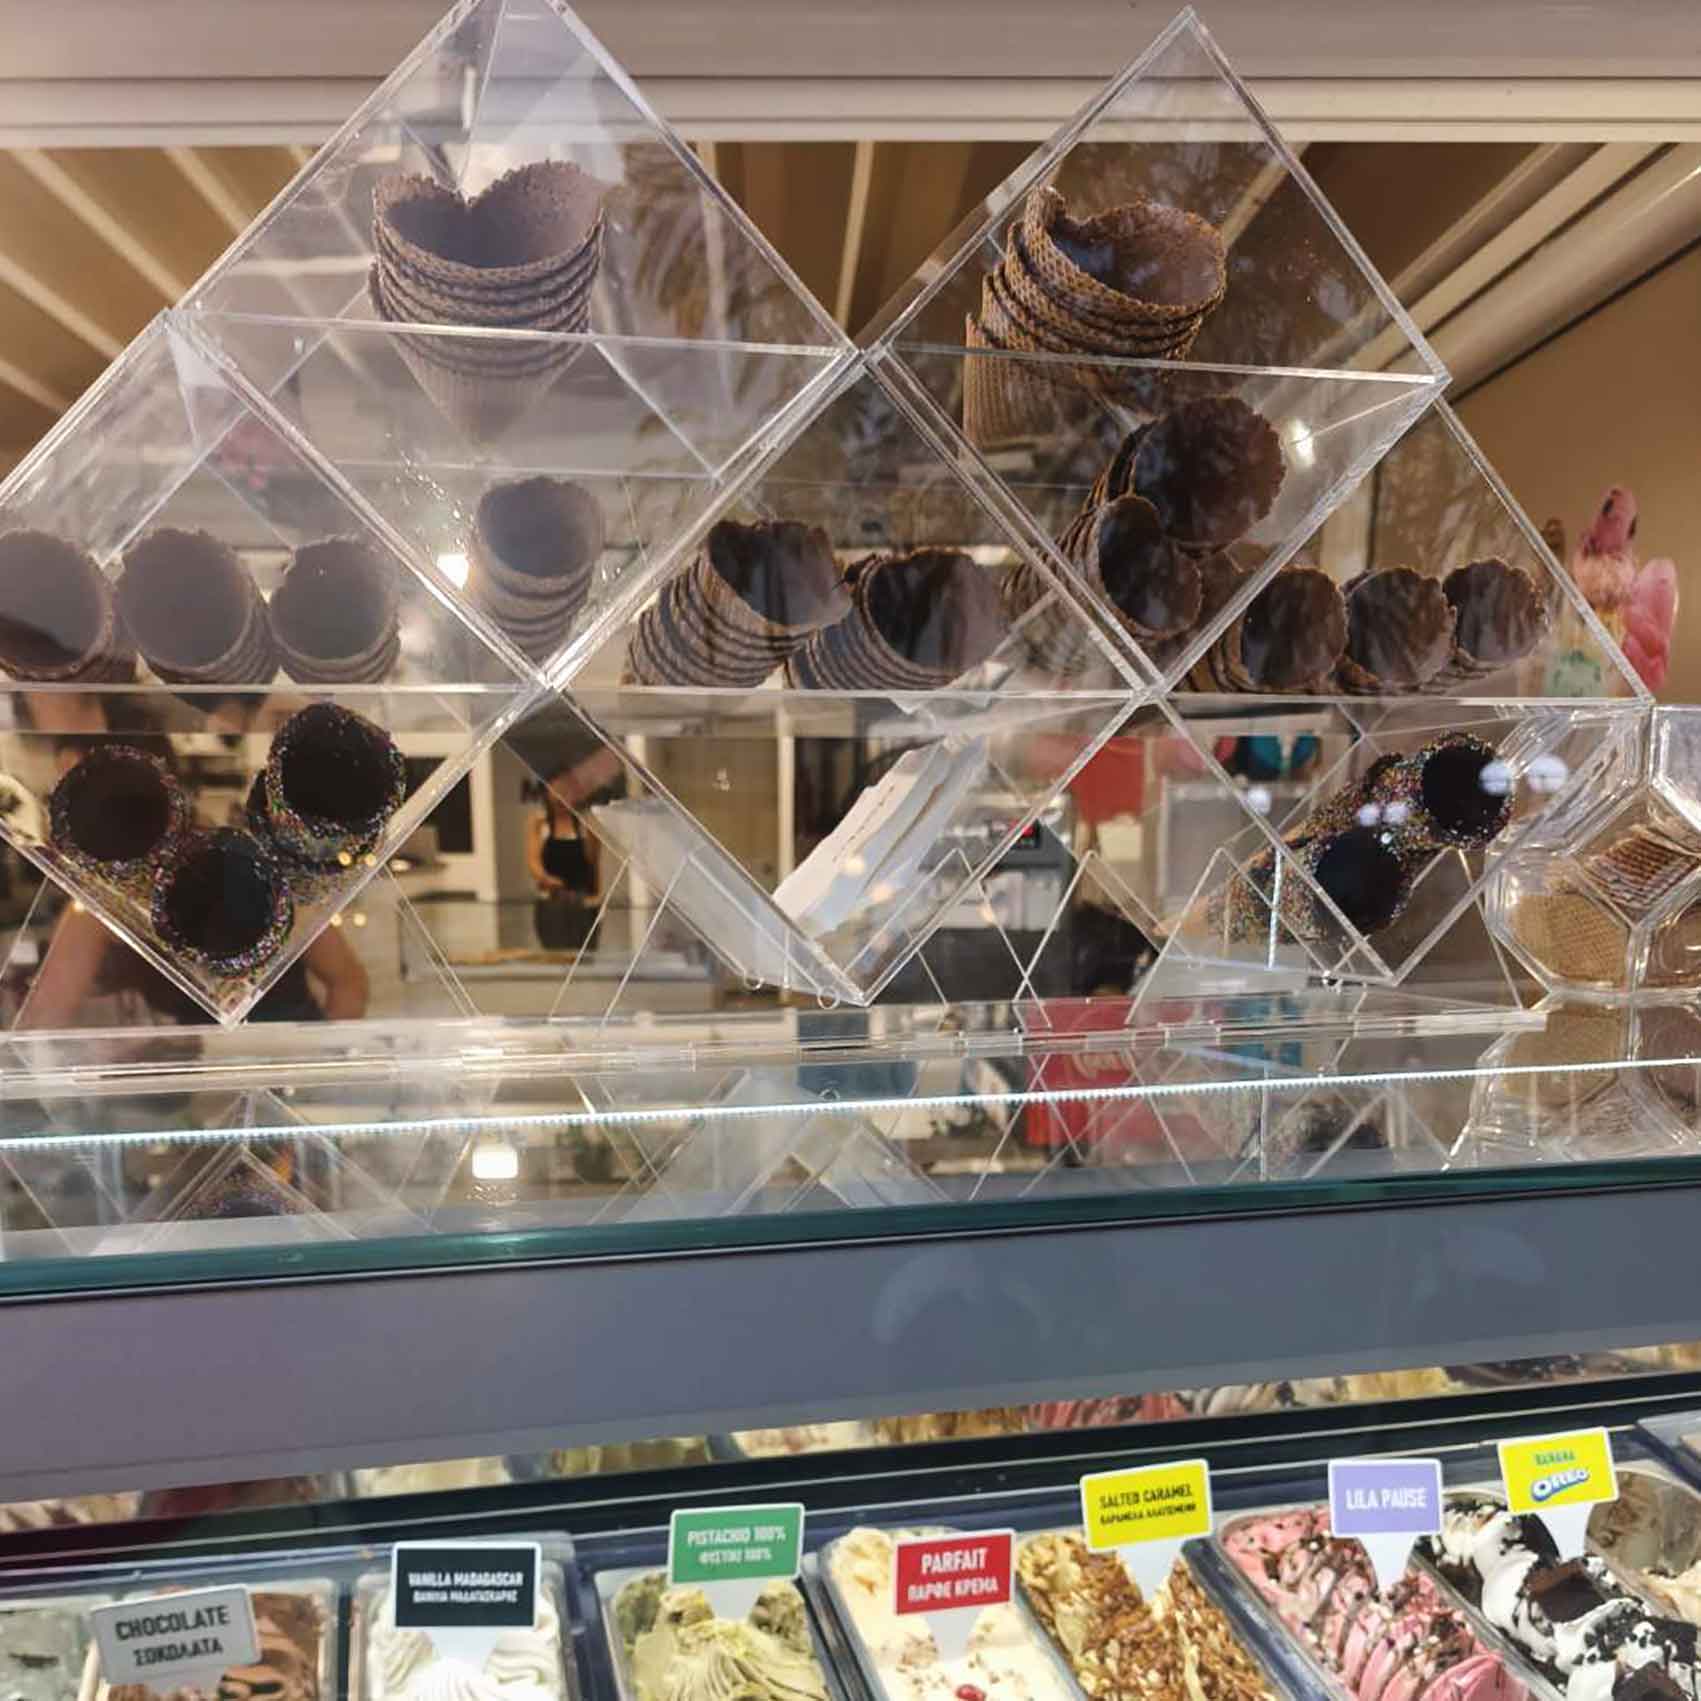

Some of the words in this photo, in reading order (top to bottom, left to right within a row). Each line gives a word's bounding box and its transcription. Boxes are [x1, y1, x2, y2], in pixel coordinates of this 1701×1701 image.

[1099, 1491, 1140, 1508] SALTED
[1142, 1484, 1193, 1502] CARAMEL
[1345, 1488, 1378, 1510] LILA
[1381, 1487, 1427, 1508] PAUSE
[687, 1528, 750, 1546] PISTACHIO
[753, 1525, 786, 1541] 100%
[922, 1547, 987, 1574] PARFAIT
[408, 1572, 451, 1587] VANILLA
[453, 1572, 523, 1587] MADAGASCAR
[115, 1605, 231, 1640] CHOCOLATE
[133, 1637, 223, 1666] ΣΟΚΟΛΑΤΑ
